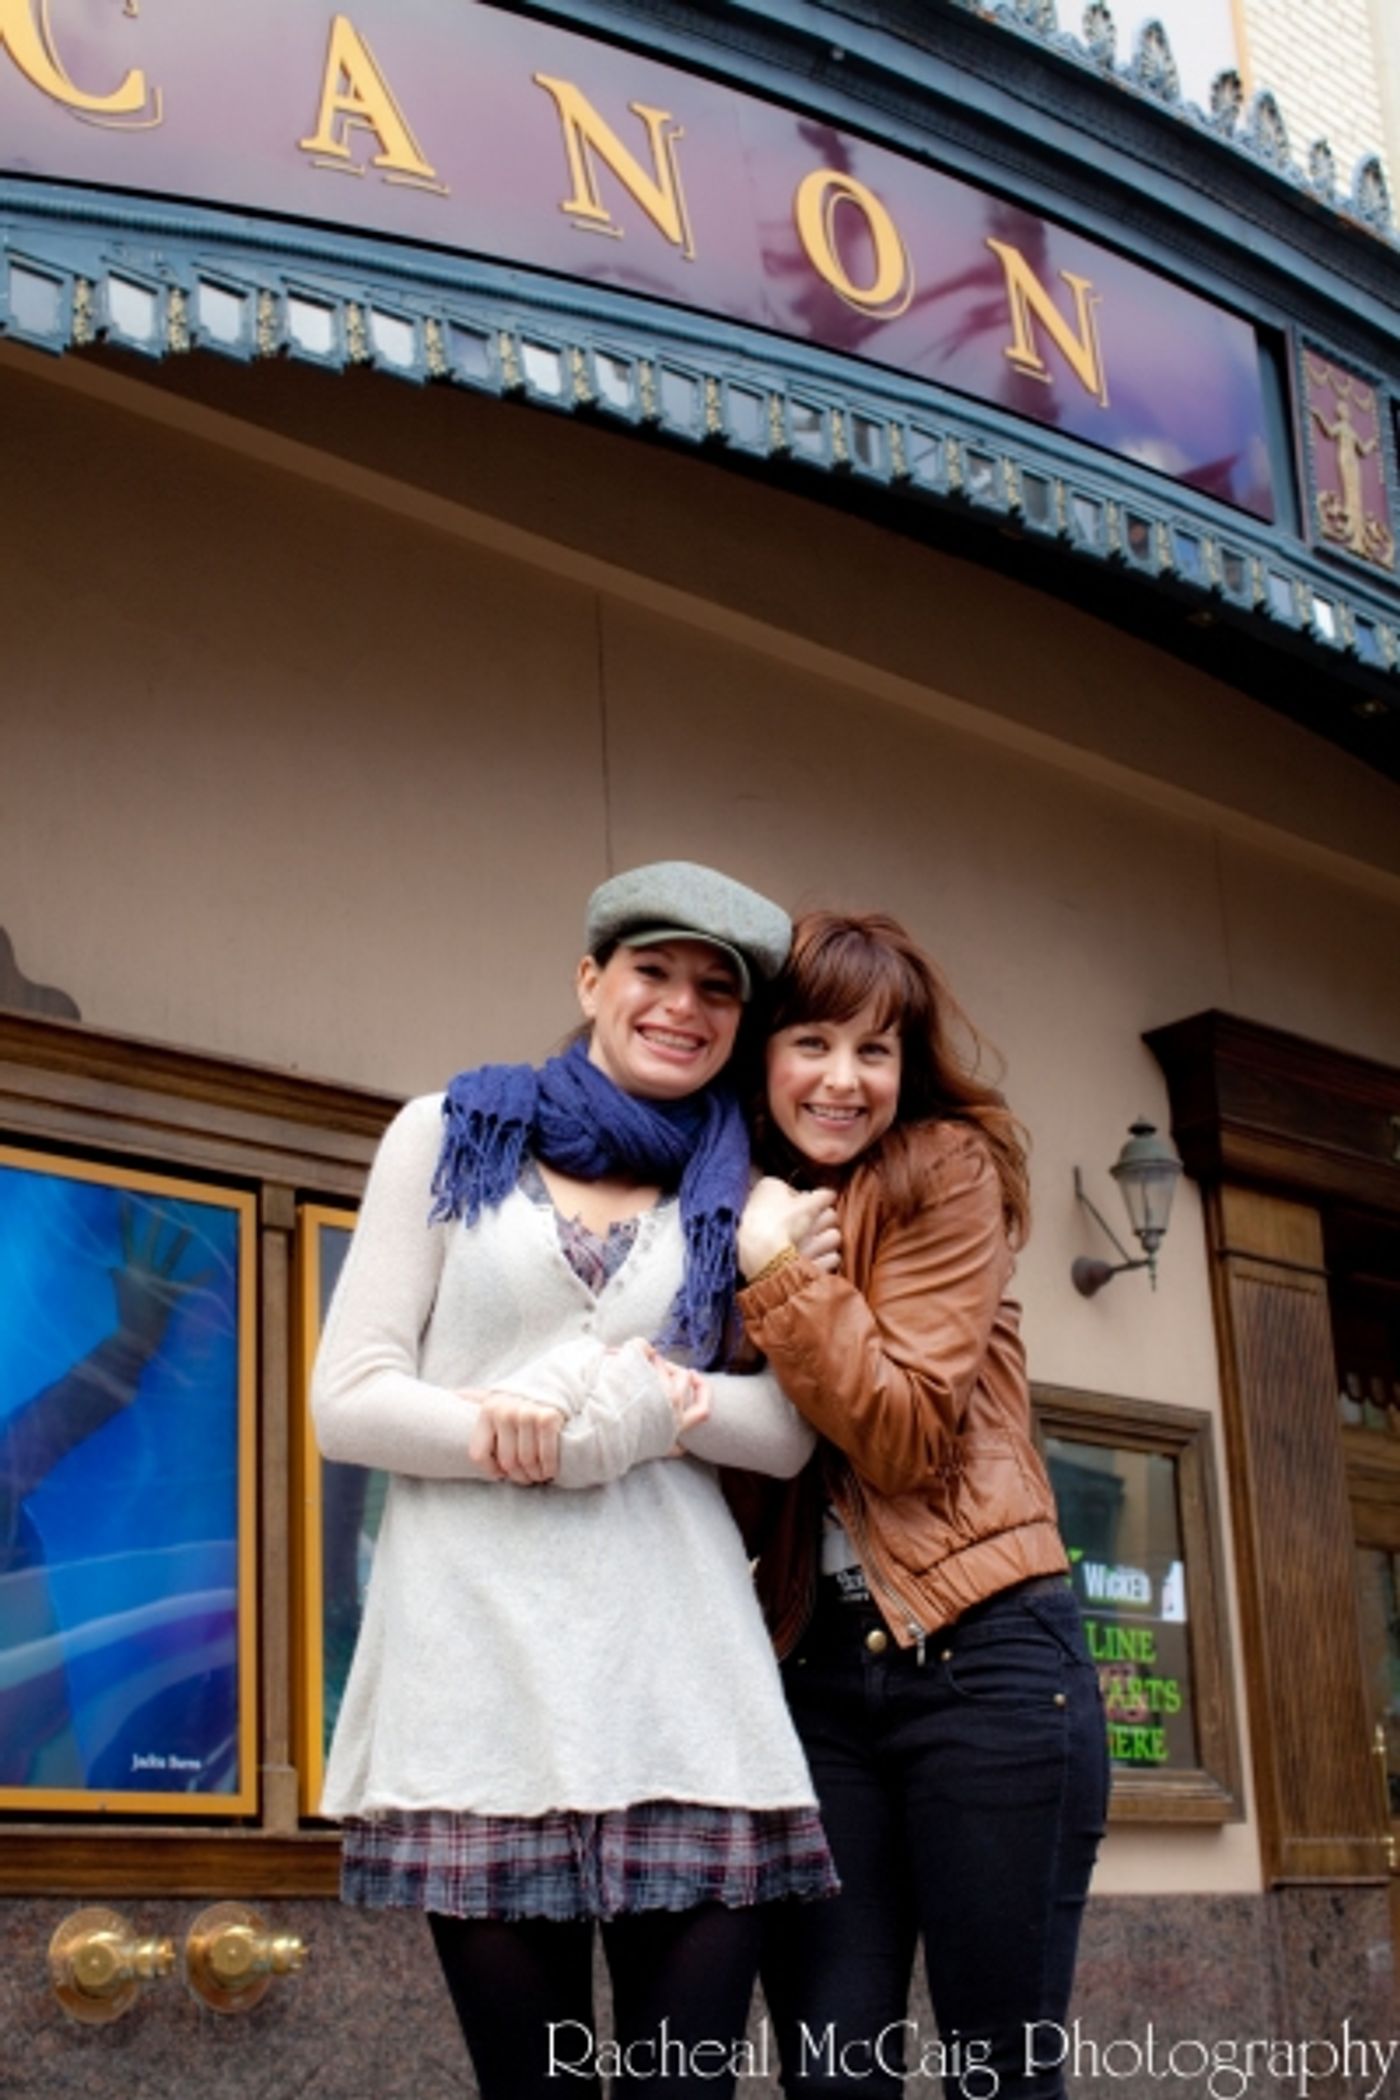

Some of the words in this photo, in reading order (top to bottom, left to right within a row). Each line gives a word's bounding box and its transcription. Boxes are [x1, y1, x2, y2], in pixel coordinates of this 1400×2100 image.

[0, 0, 1110, 406] CANON
[1085, 1621, 1156, 1663] LINE
[1104, 1677, 1182, 1714] ARTS
